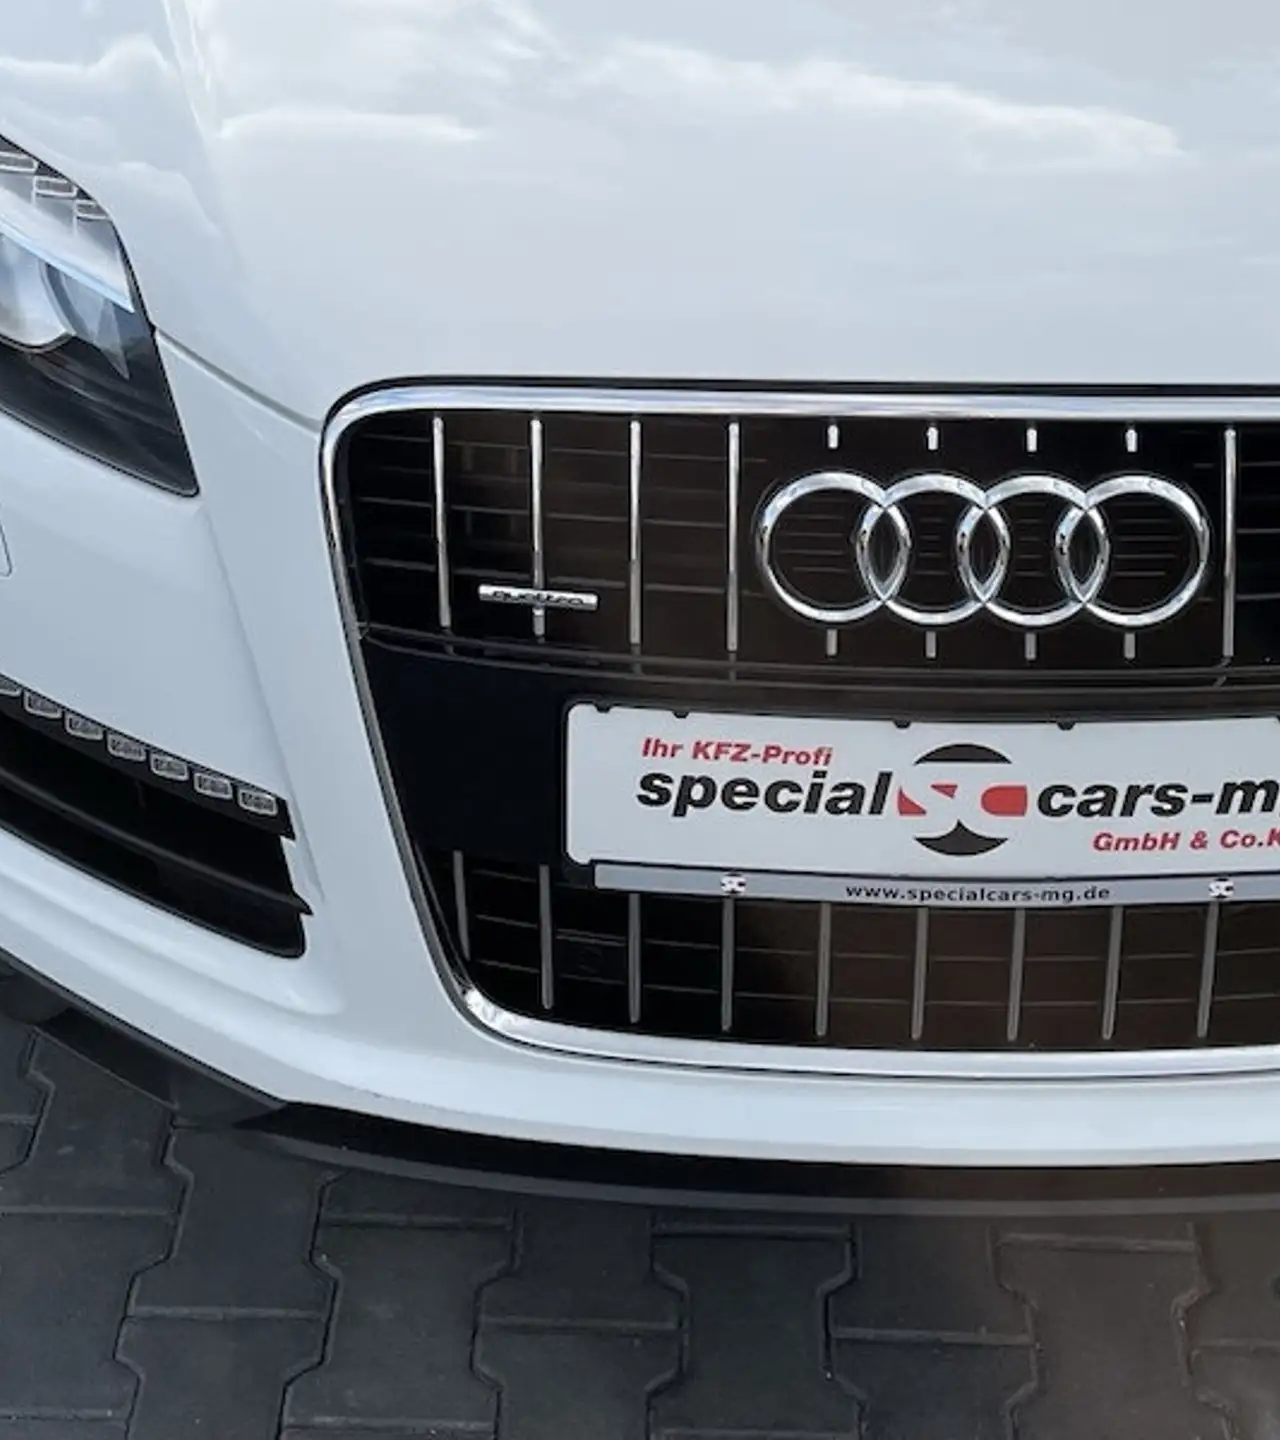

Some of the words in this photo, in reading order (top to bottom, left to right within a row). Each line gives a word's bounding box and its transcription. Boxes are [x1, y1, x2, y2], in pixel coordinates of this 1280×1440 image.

[642, 737, 683, 758] Ihr
[692, 739, 833, 766] KFZ-Profi
[636, 769, 893, 817] special
[1092, 832, 1180, 851] GmbH
[1189, 831, 1208, 849] &
[845, 883, 1111, 904] www.specialcars-mg.de
